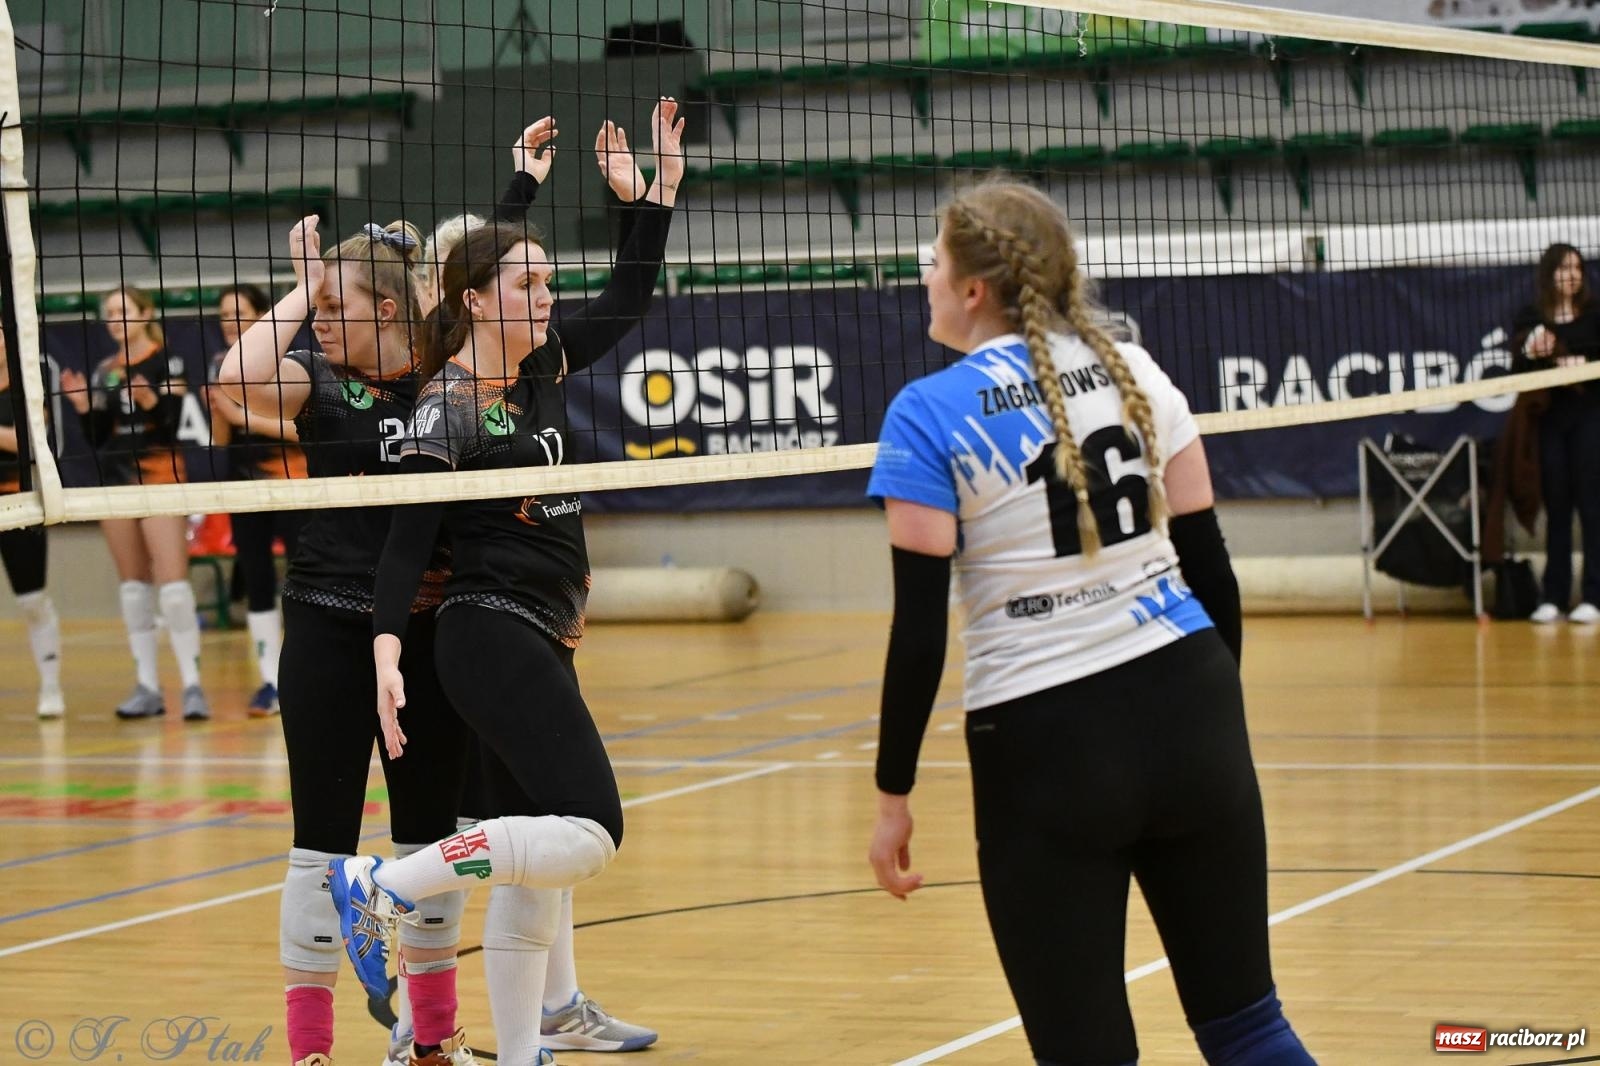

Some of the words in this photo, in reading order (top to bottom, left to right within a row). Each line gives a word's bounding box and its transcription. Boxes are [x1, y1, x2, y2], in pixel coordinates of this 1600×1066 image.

[621, 345, 839, 428] OSiR
[542, 497, 582, 518] Fundacja
[1024, 425, 1151, 557] 16
[1056, 581, 1118, 608] Technik
